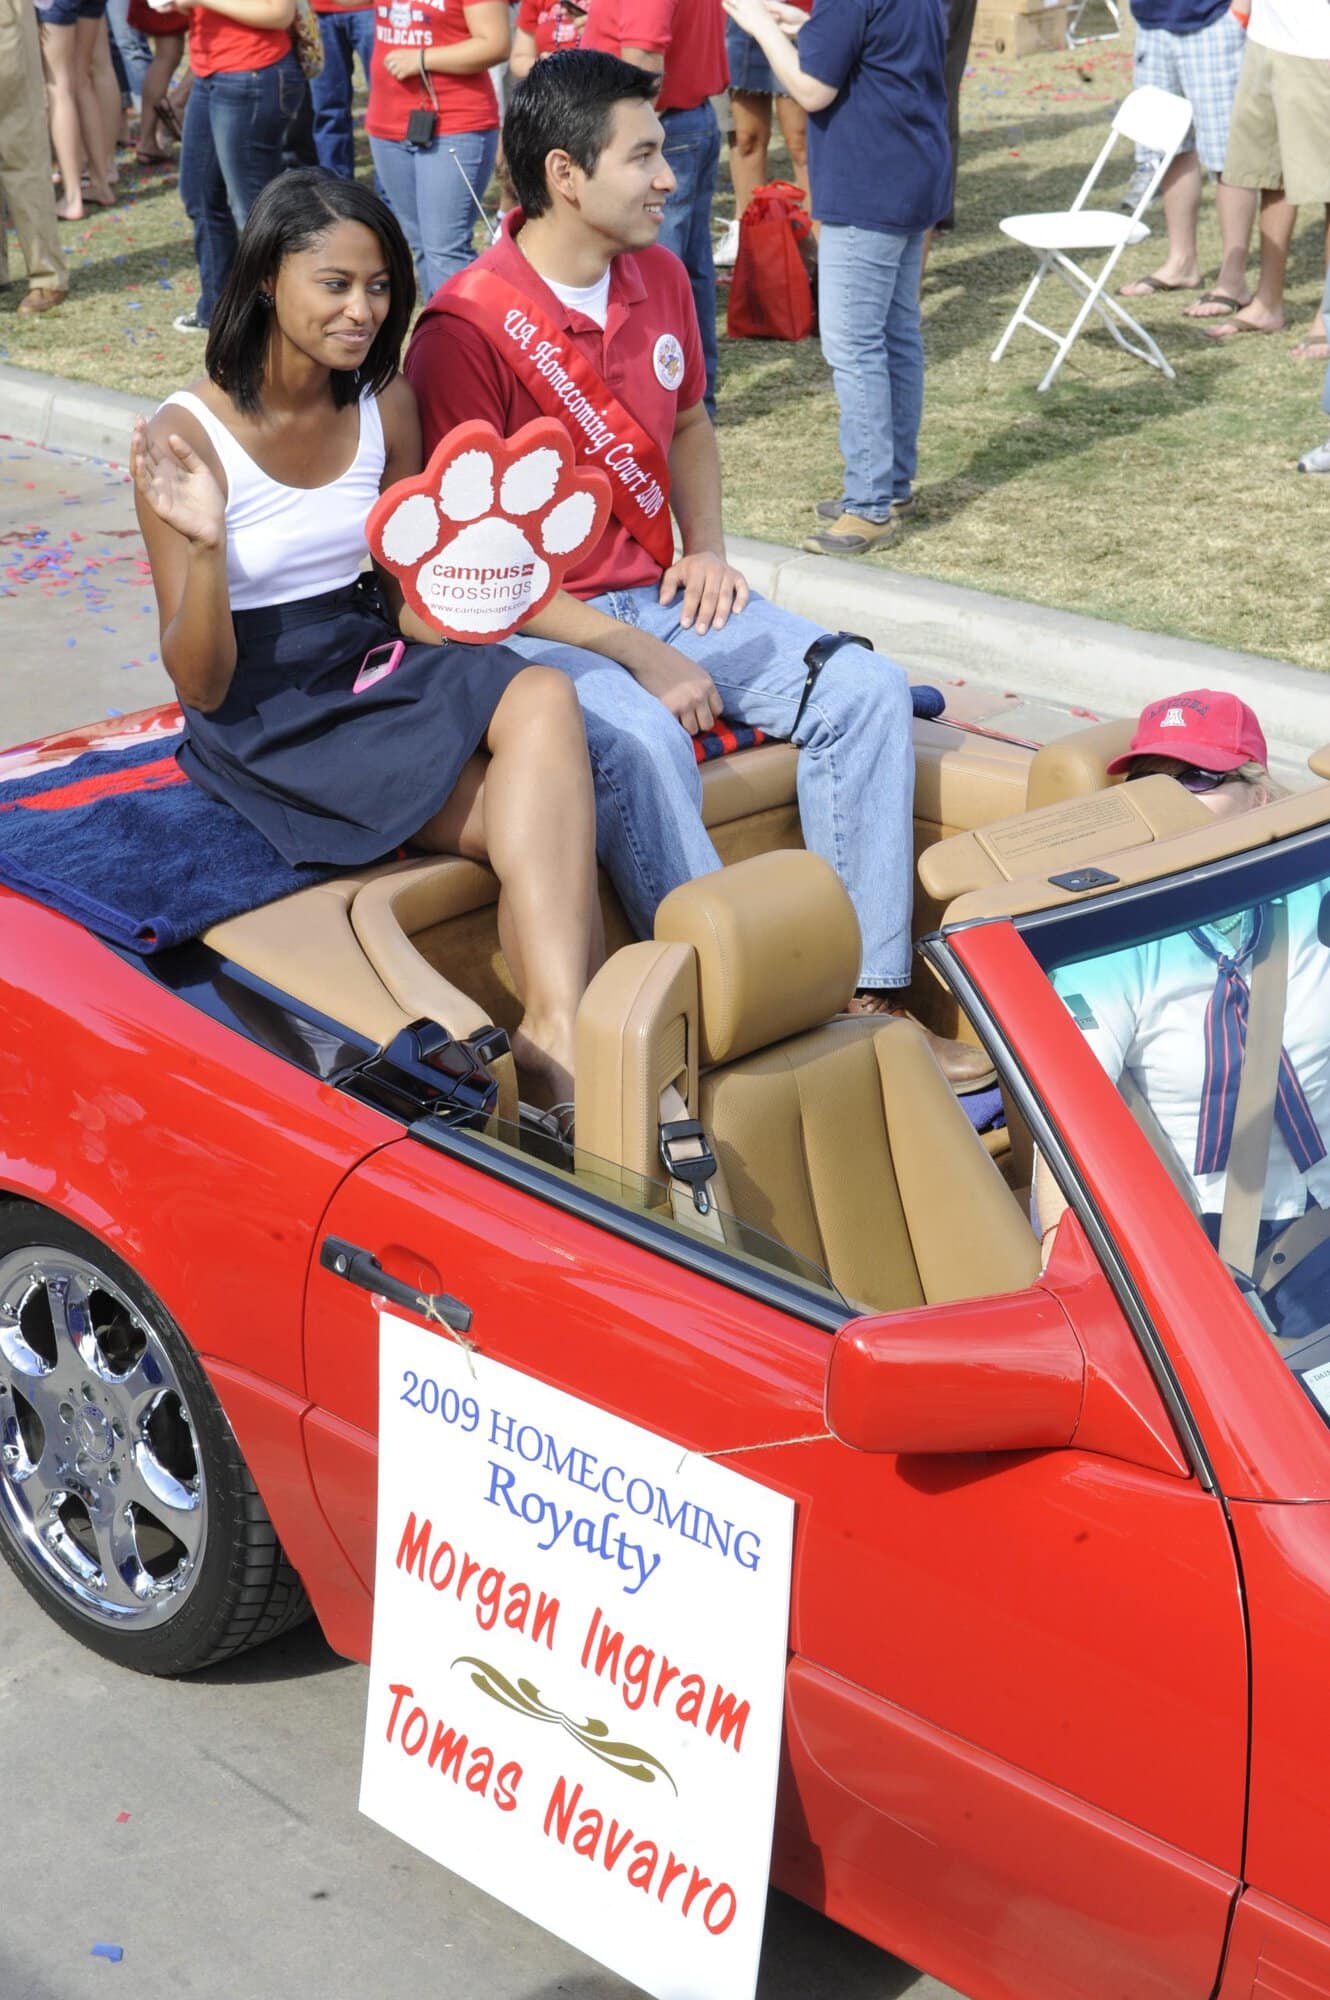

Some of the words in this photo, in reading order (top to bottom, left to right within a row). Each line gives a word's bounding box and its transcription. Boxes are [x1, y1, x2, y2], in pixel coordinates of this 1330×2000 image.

[503, 308, 539, 350] UA
[529, 340, 617, 455] Homecoming
[604, 442, 653, 492] Court
[635, 477, 665, 519] 2009
[430, 580, 532, 601] crossings
[432, 563, 520, 585] campus
[401, 1370, 480, 1432] 2009
[489, 1408, 762, 1572] HOMECOMING
[484, 1461, 661, 1595] Royalty
[395, 1511, 561, 1650] Morgan
[580, 1606, 752, 1753] Ingram
[384, 1683, 523, 1812] Tomas
[543, 1775, 737, 1936] Navarro
